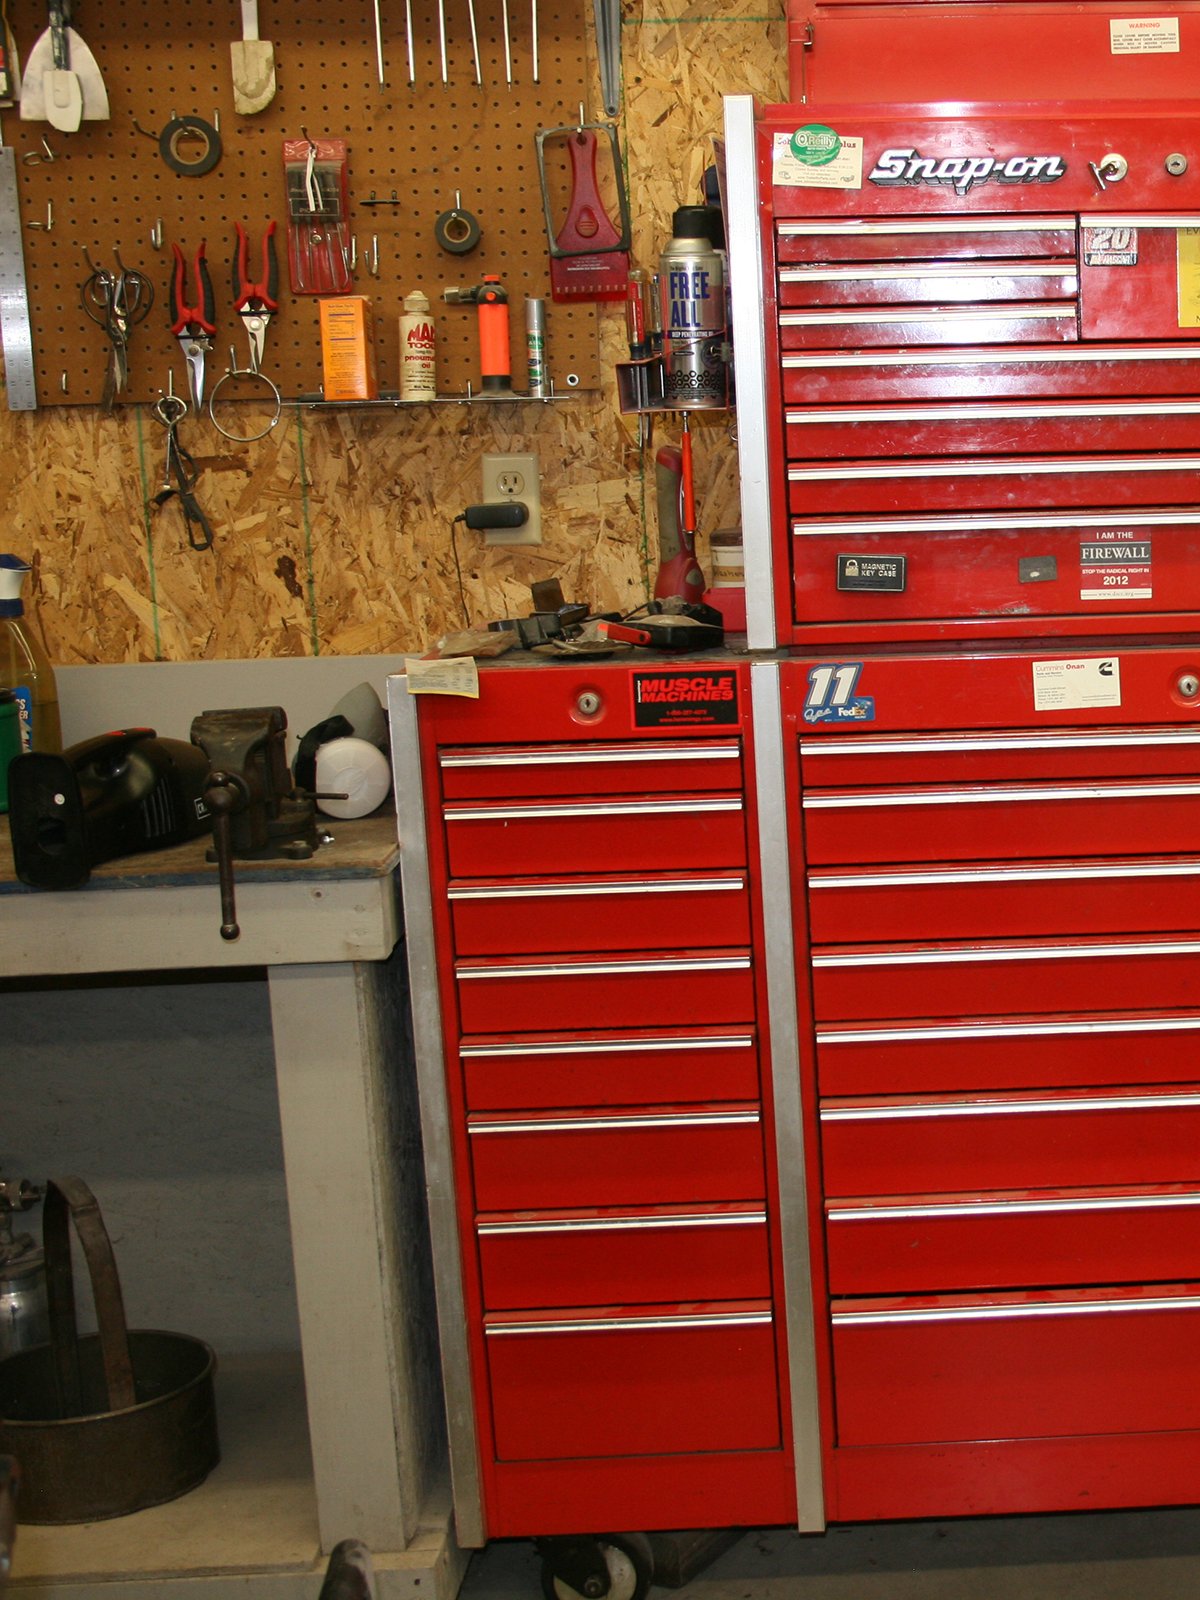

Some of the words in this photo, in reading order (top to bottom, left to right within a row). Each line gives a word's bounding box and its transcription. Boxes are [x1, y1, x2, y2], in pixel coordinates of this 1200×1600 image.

[796, 132, 836, 149] O'Reilly
[868, 149, 1066, 195] Snap-on
[1090, 228, 1131, 250] 20
[670, 272, 710, 299] FREE
[672, 301, 701, 327] ALL
[1082, 547, 1149, 559] FIREWALL
[861, 563, 897, 571] MAGNETIC
[1103, 576, 1129, 586] 2012
[641, 677, 733, 692] MUSCLE
[807, 666, 859, 707] 11
[641, 690, 734, 702] MACHINES
[838, 707, 866, 717] FedEx
